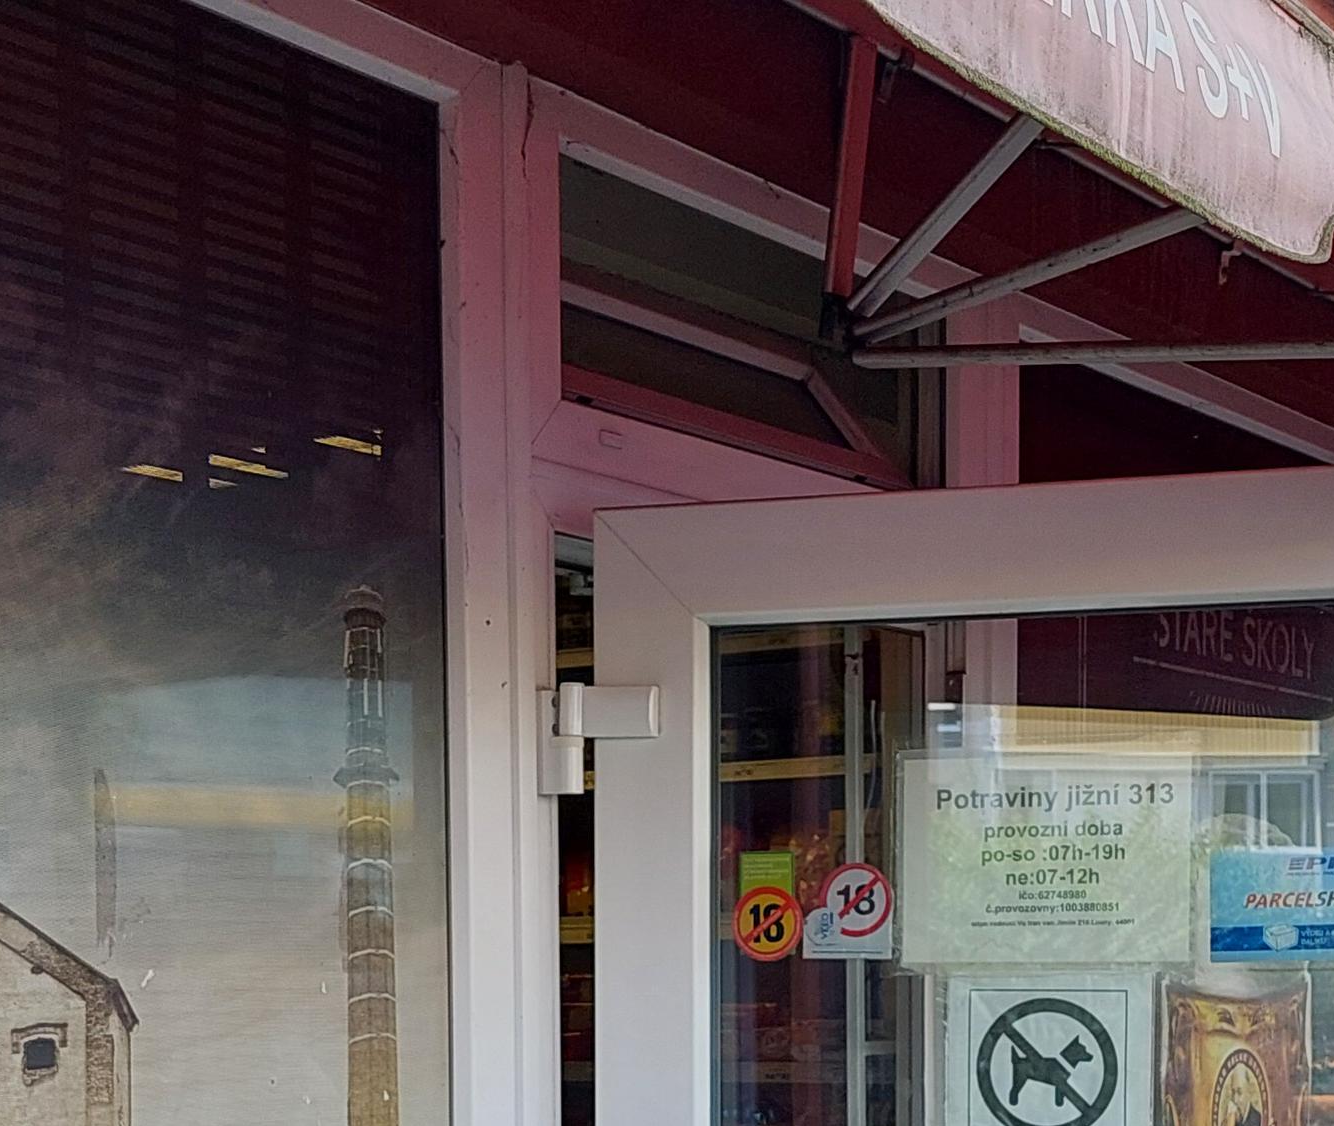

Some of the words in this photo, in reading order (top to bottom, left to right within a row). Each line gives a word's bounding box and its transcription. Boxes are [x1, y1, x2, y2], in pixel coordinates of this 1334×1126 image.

[936, 786, 1058, 813] Potraviny
[1065, 783, 1120, 812] jižní
[1128, 782, 1174, 805] 313
[1074, 819, 1123, 838] doba
[981, 848, 1036, 866] po-so
[1005, 867, 1100, 886] ne:07-12h
[836, 883, 876, 916] 18
[748, 903, 785, 943] 18
